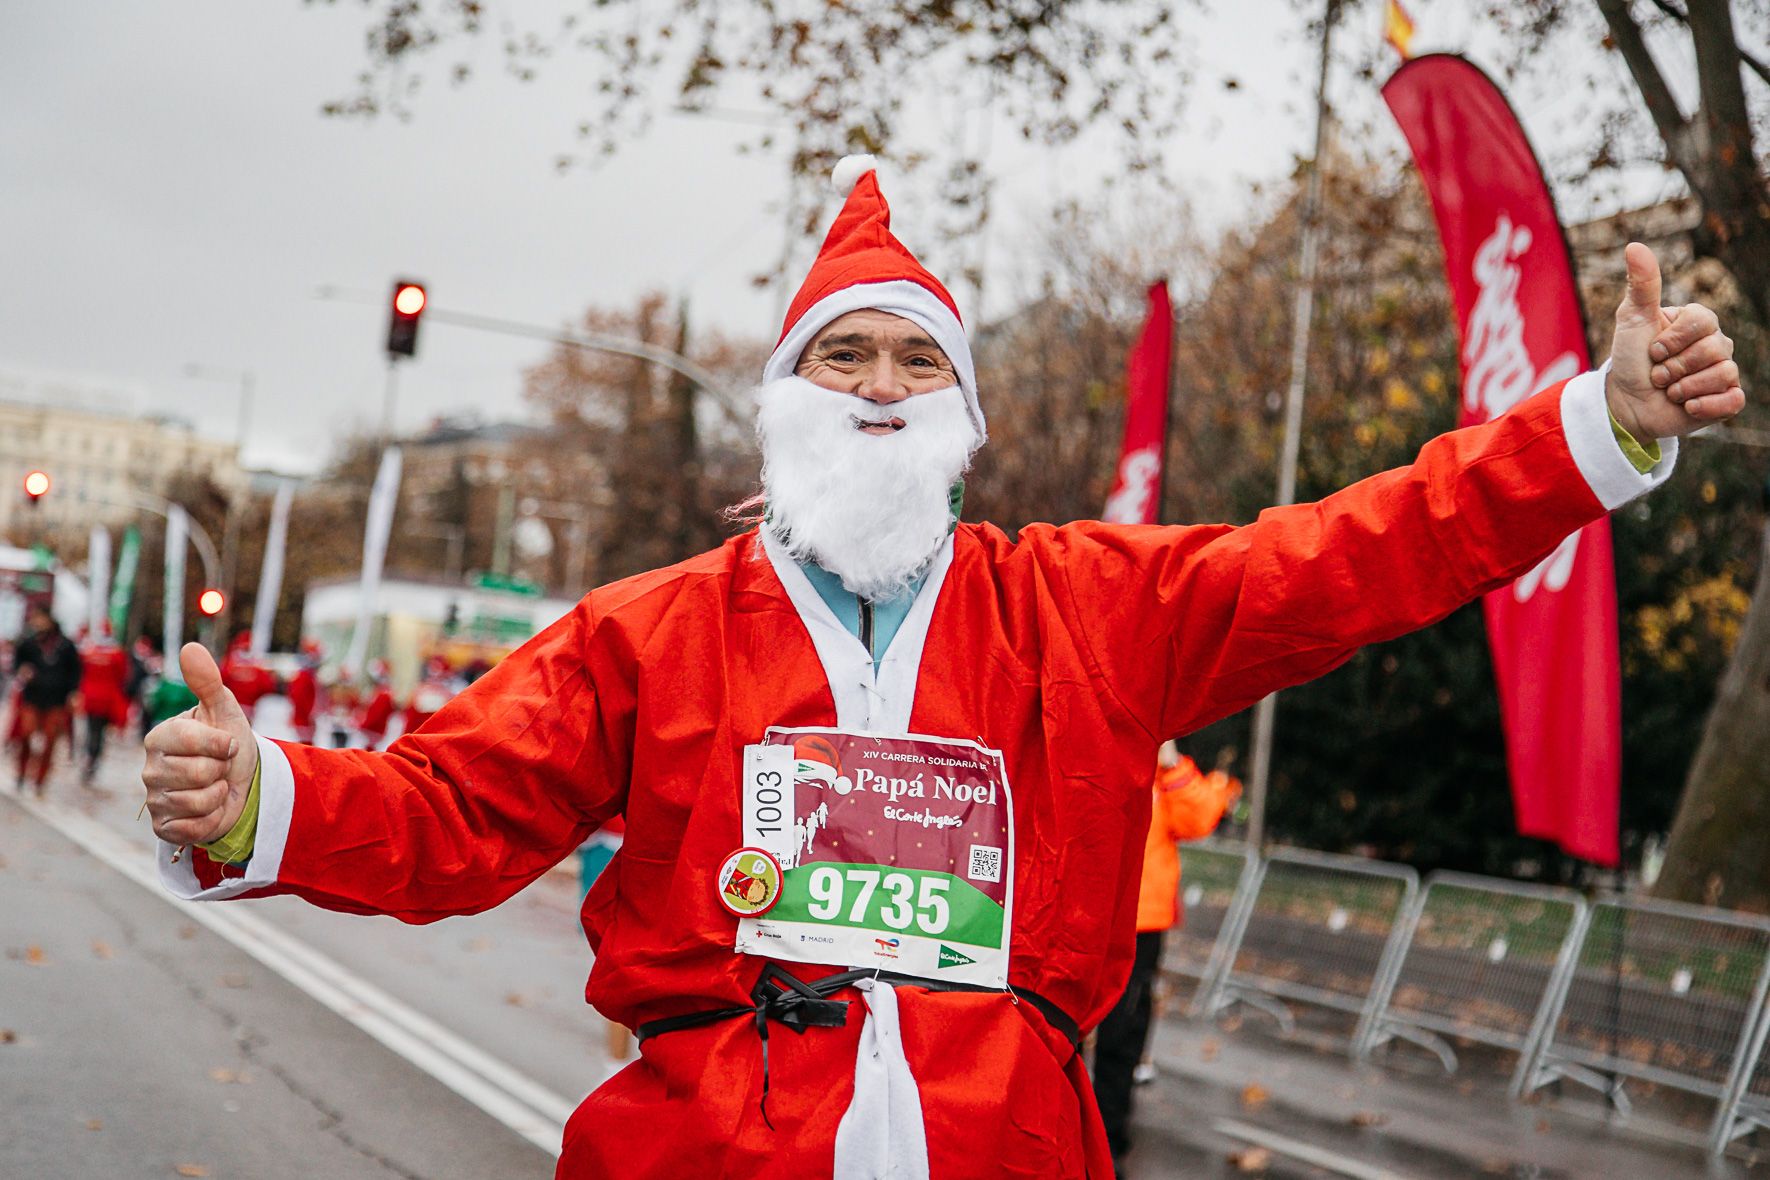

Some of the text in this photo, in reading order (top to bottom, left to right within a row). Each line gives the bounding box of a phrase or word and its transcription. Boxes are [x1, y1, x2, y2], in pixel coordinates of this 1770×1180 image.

[863, 751, 879, 759] XIV
[881, 752, 925, 764] CARRERA
[928, 757, 978, 769] SOLIDARIA
[756, 771, 782, 837] 1003
[853, 768, 997, 806] Papá Noel
[808, 867, 950, 935] 9735
[808, 936, 834, 944] MADRID
